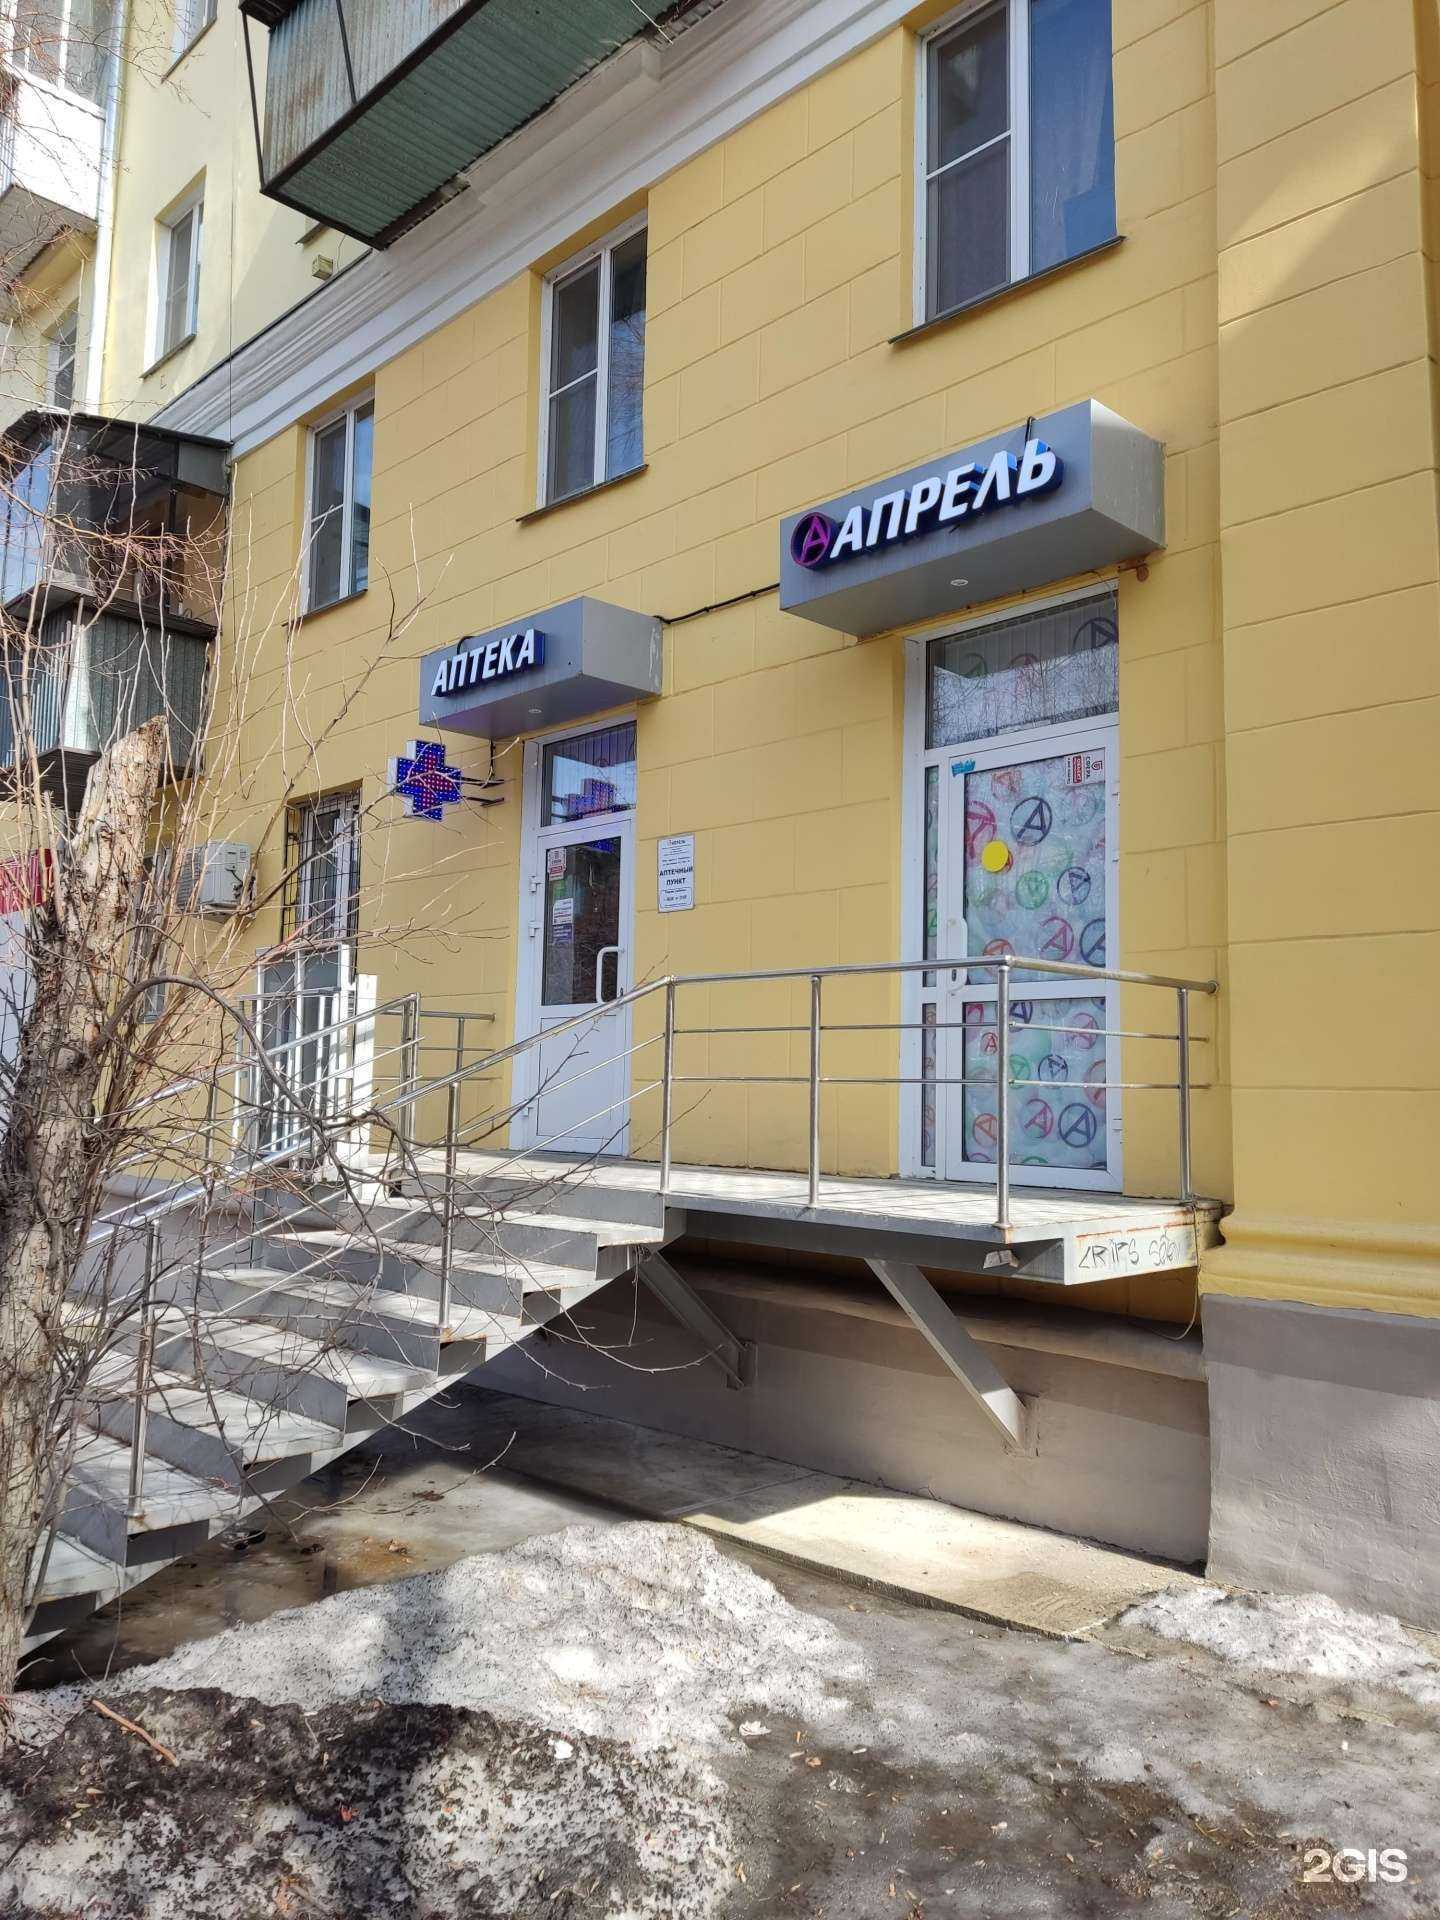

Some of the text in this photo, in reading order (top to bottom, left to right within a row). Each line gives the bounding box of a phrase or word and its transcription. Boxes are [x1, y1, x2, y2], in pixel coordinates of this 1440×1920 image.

[829, 438, 1058, 559] АПРЕЛЬ
[430, 628, 536, 697] АПТЕКА
[666, 876, 687, 885] ПУНКТ
